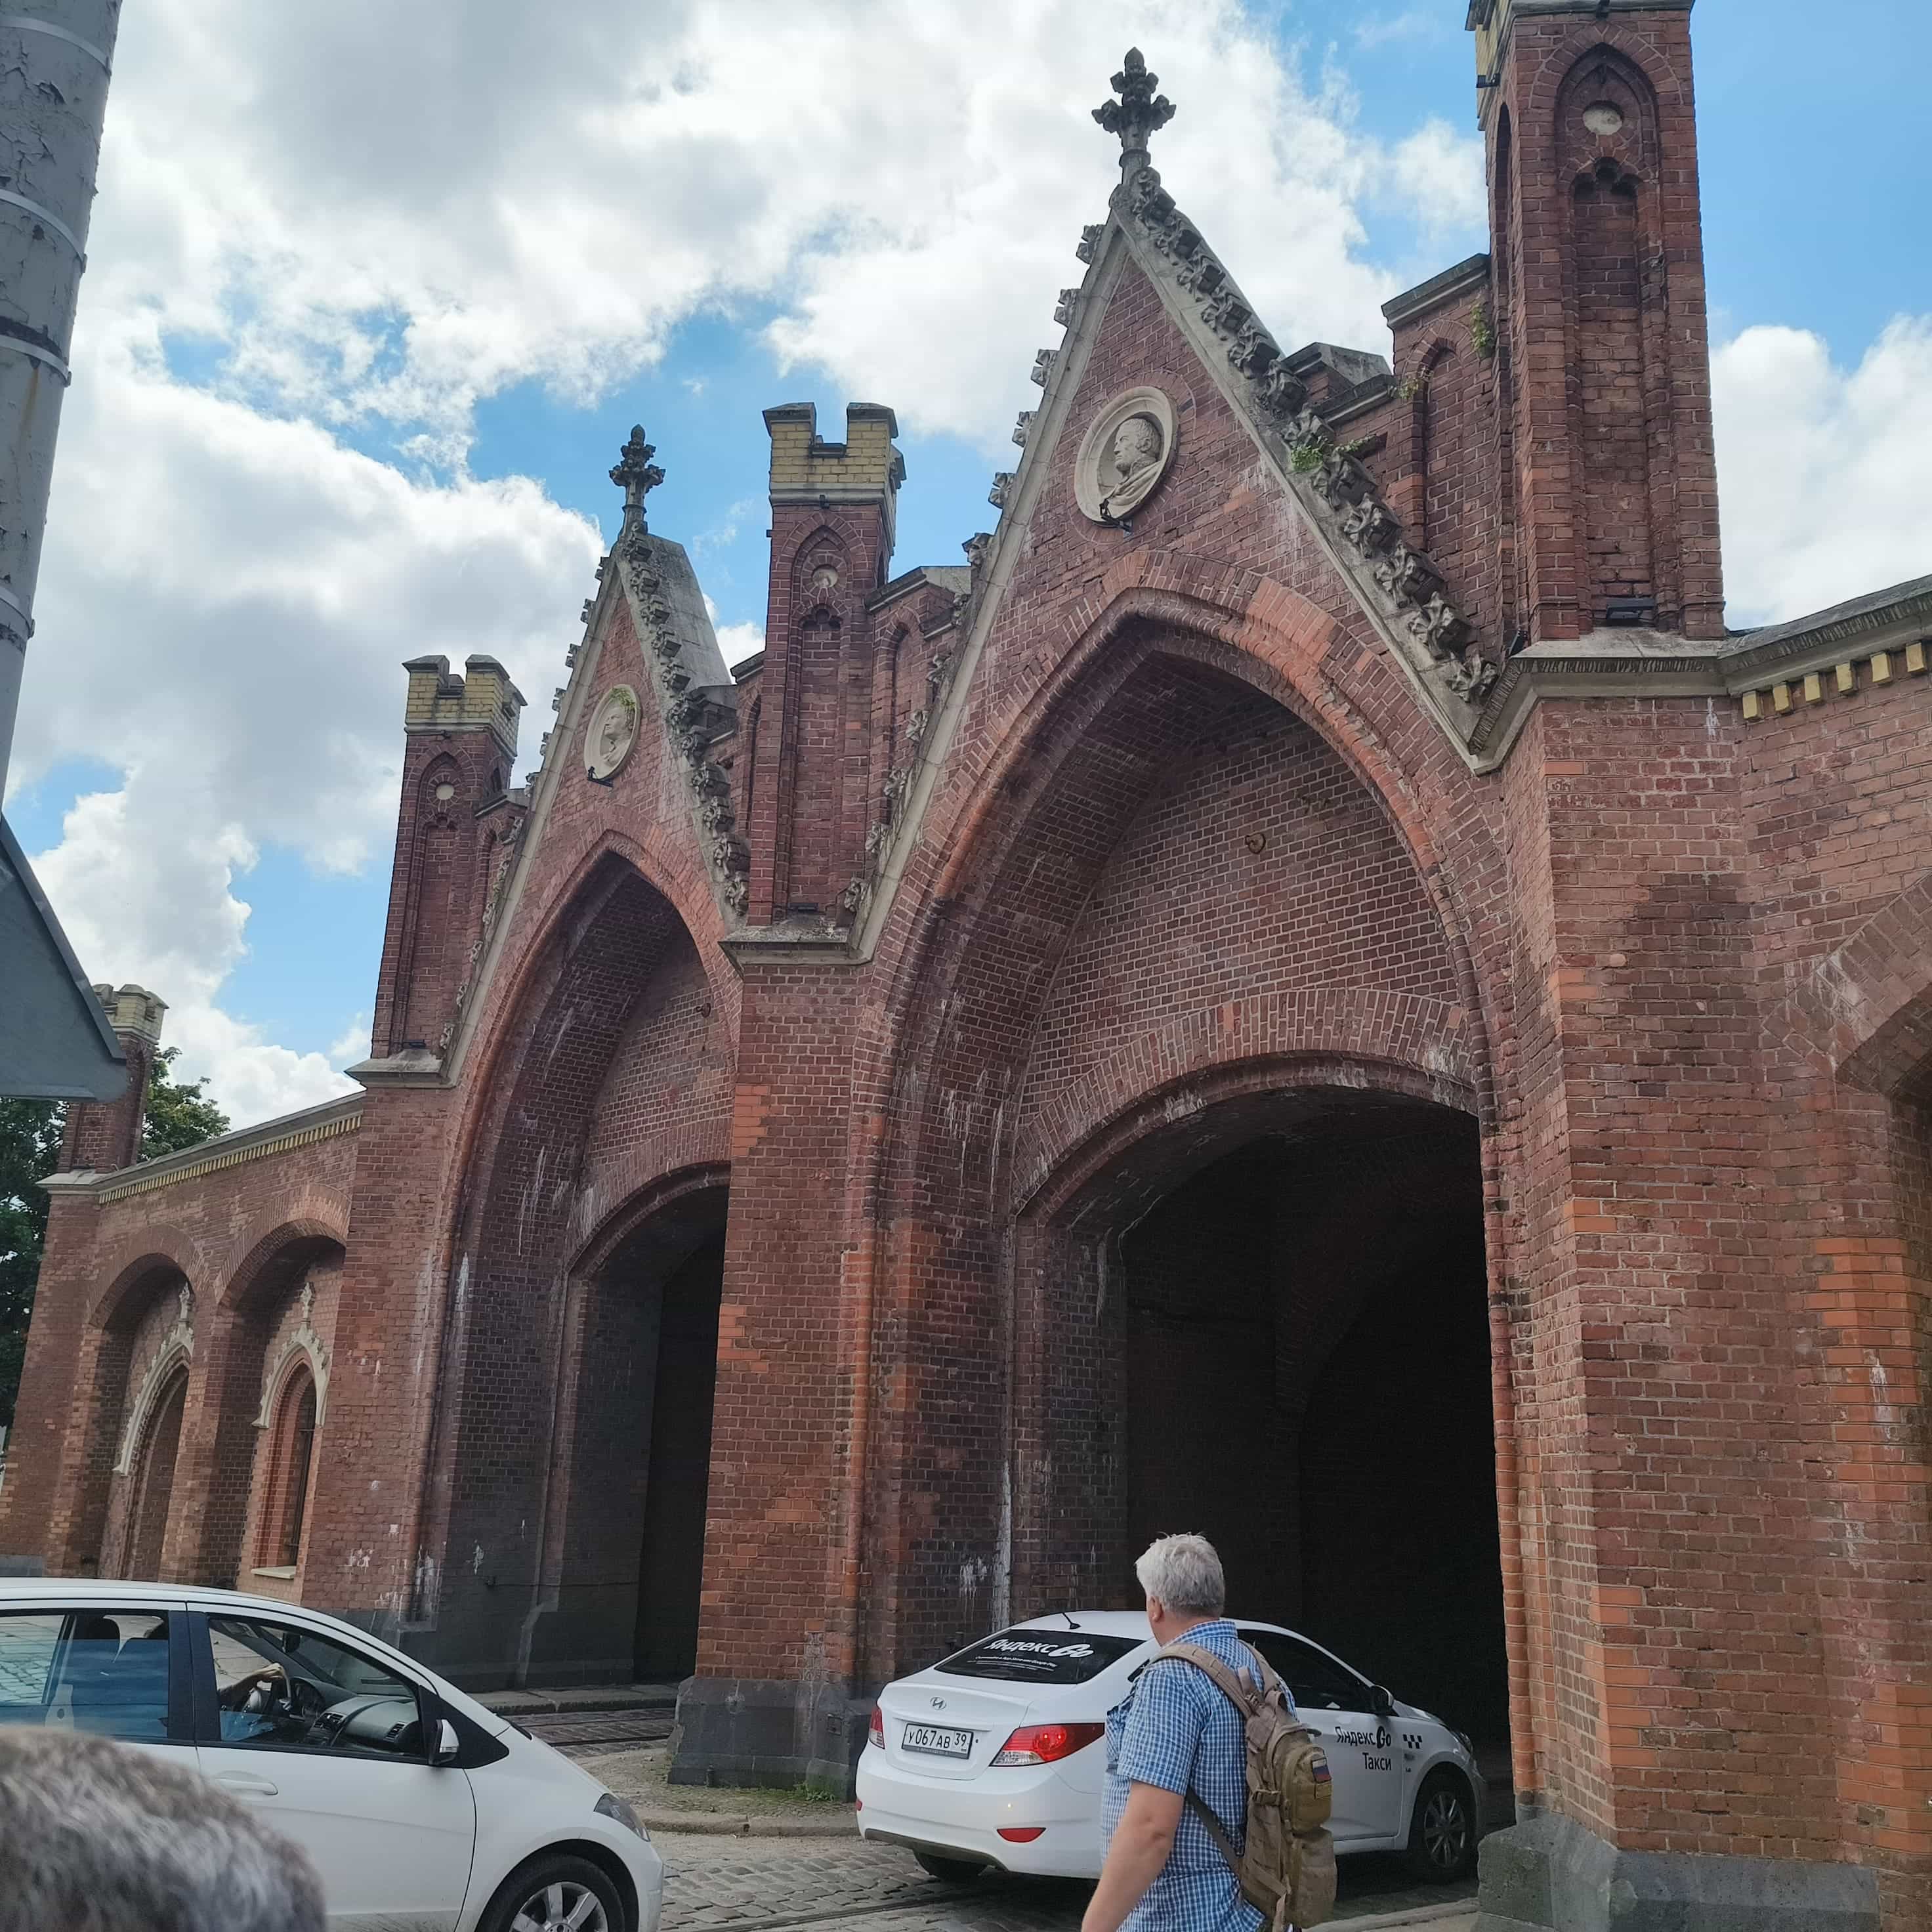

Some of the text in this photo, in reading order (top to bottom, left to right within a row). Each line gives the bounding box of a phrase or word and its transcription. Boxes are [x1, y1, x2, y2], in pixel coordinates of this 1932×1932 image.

[984, 1639, 1059, 1652] Яндекс
[1335, 1725, 1391, 1749] Яндекс Go
[1362, 1752, 1391, 1770] Такси
